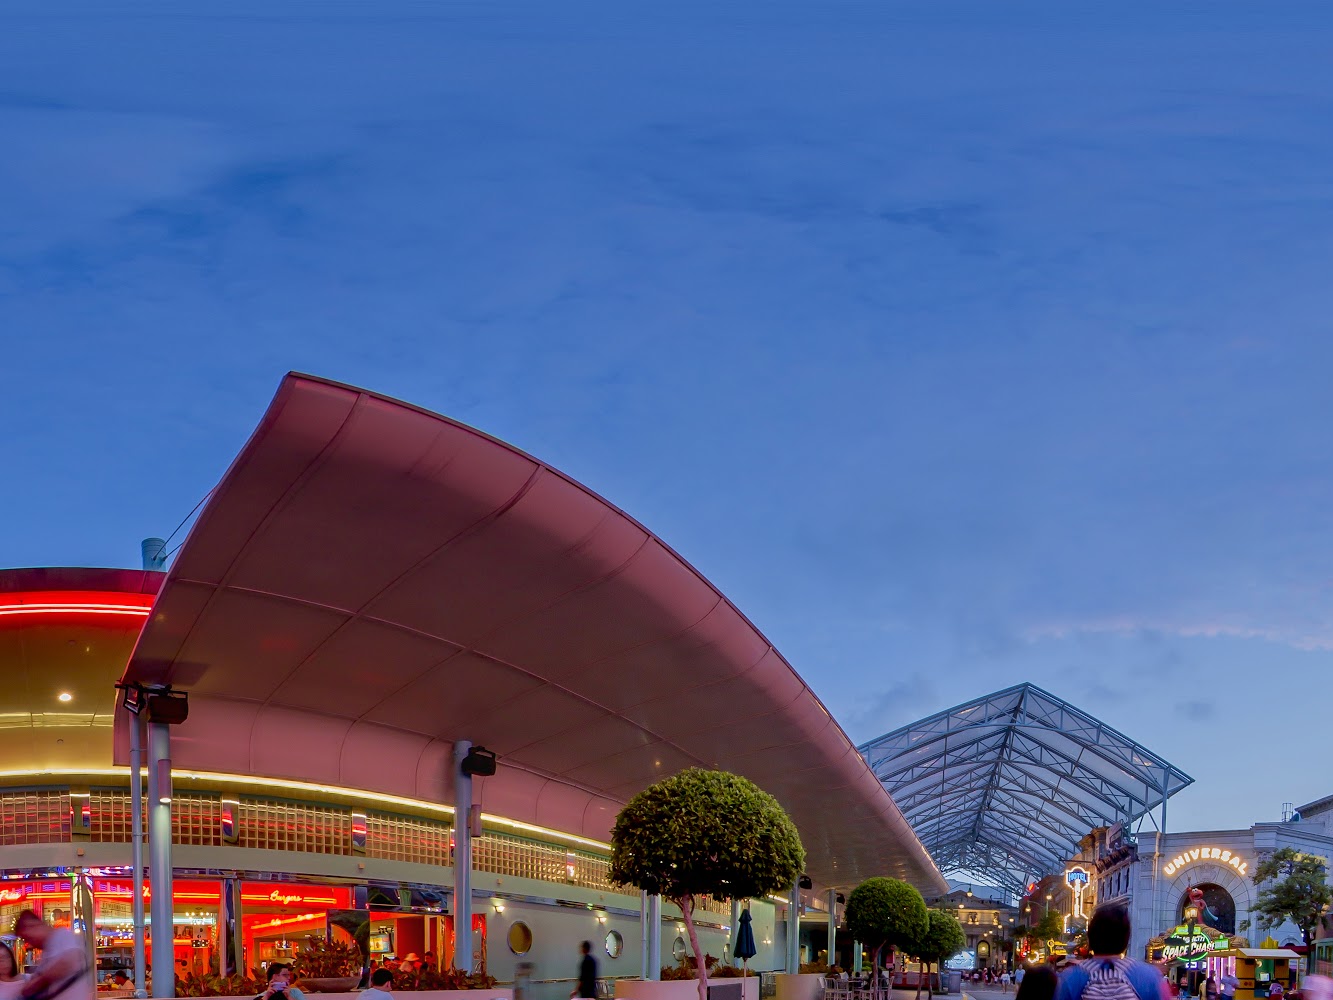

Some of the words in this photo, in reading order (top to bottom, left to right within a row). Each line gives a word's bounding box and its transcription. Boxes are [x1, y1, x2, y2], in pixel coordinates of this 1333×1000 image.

[1164, 847, 1248, 875] UNIVERSAL
[1068, 872, 1087, 883] HOTEL
[269, 890, 302, 904] Burgers
[1160, 945, 1190, 963] SPACE
